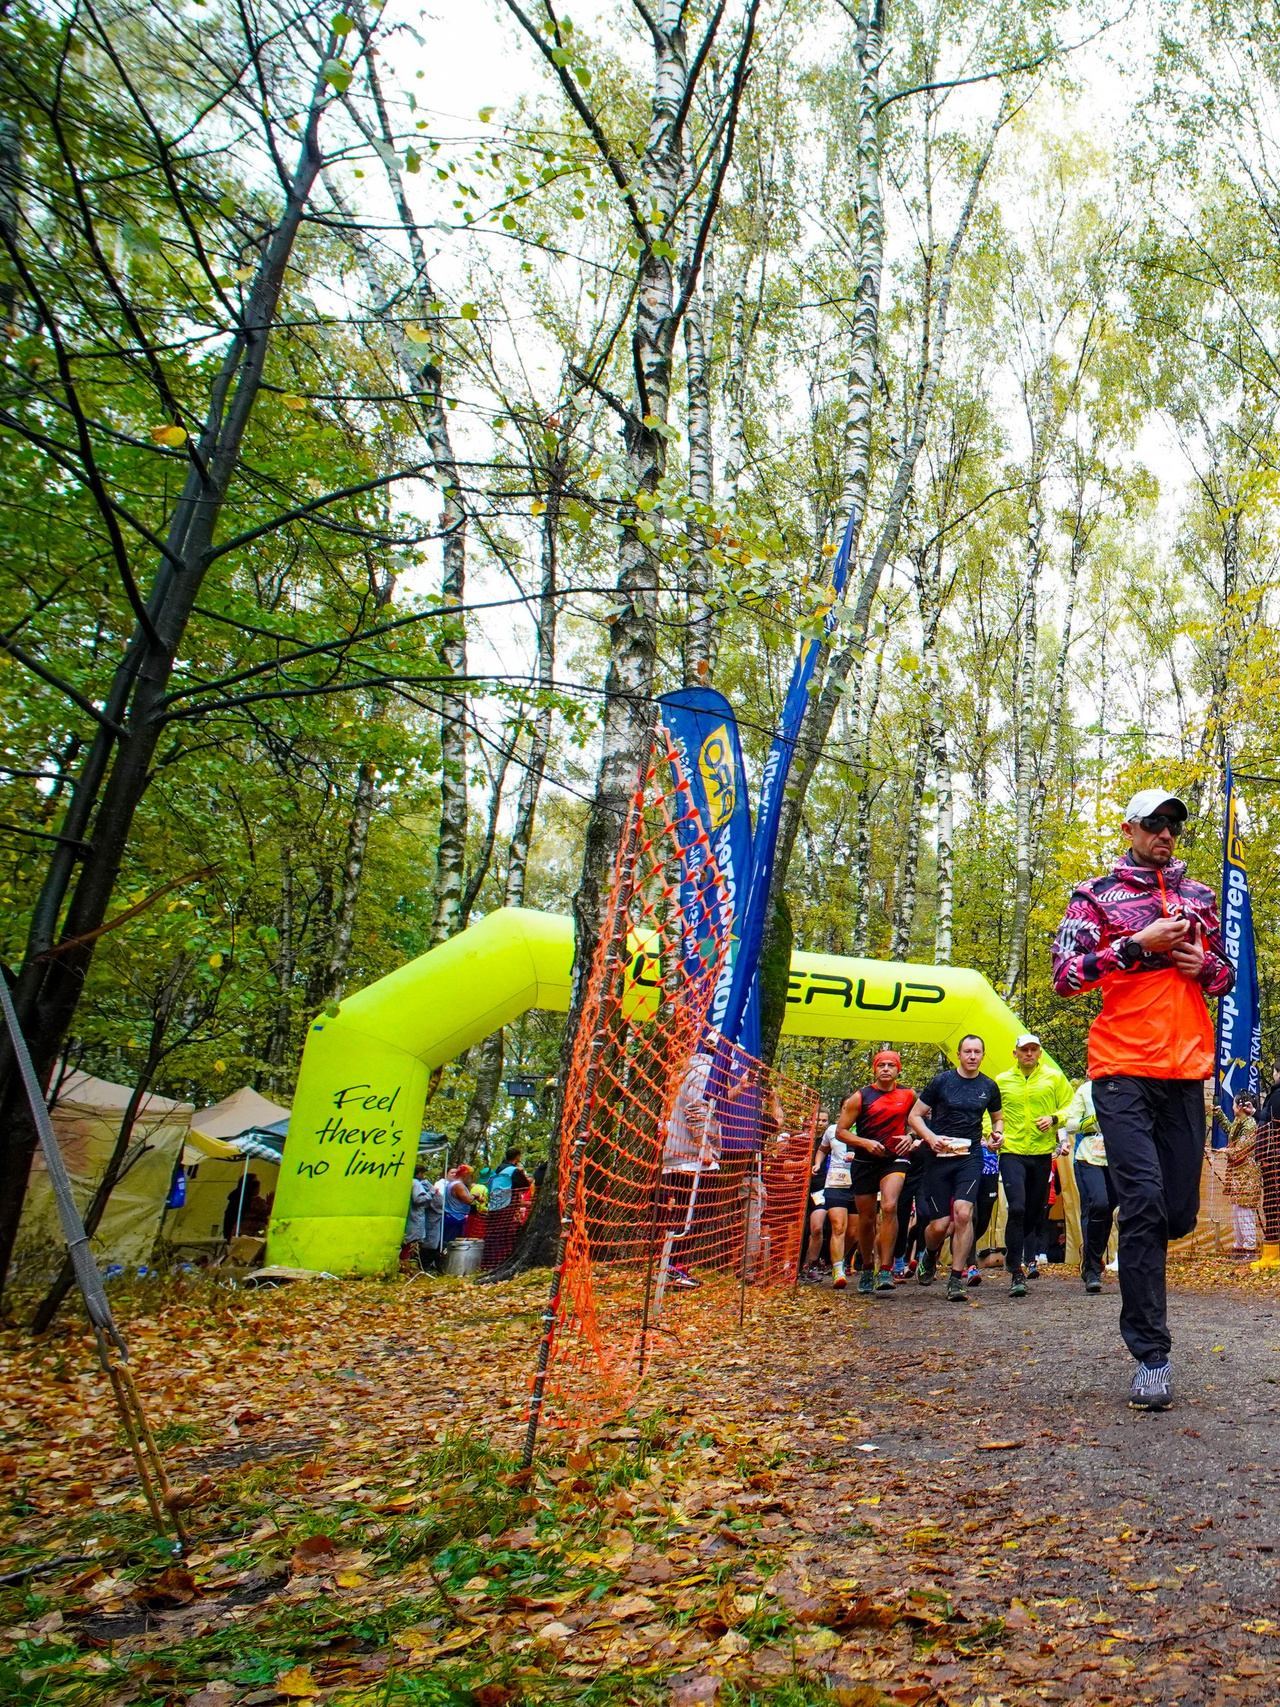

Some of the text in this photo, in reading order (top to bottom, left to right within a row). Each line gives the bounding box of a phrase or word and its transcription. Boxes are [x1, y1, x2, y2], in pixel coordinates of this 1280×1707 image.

[1220, 869, 1248, 1067] спорастер
[1249, 1022, 1261, 1062] TRAIL
[333, 1084, 401, 1112] Feel
[315, 1117, 403, 1146] there's
[297, 1148, 405, 1179] no limit
